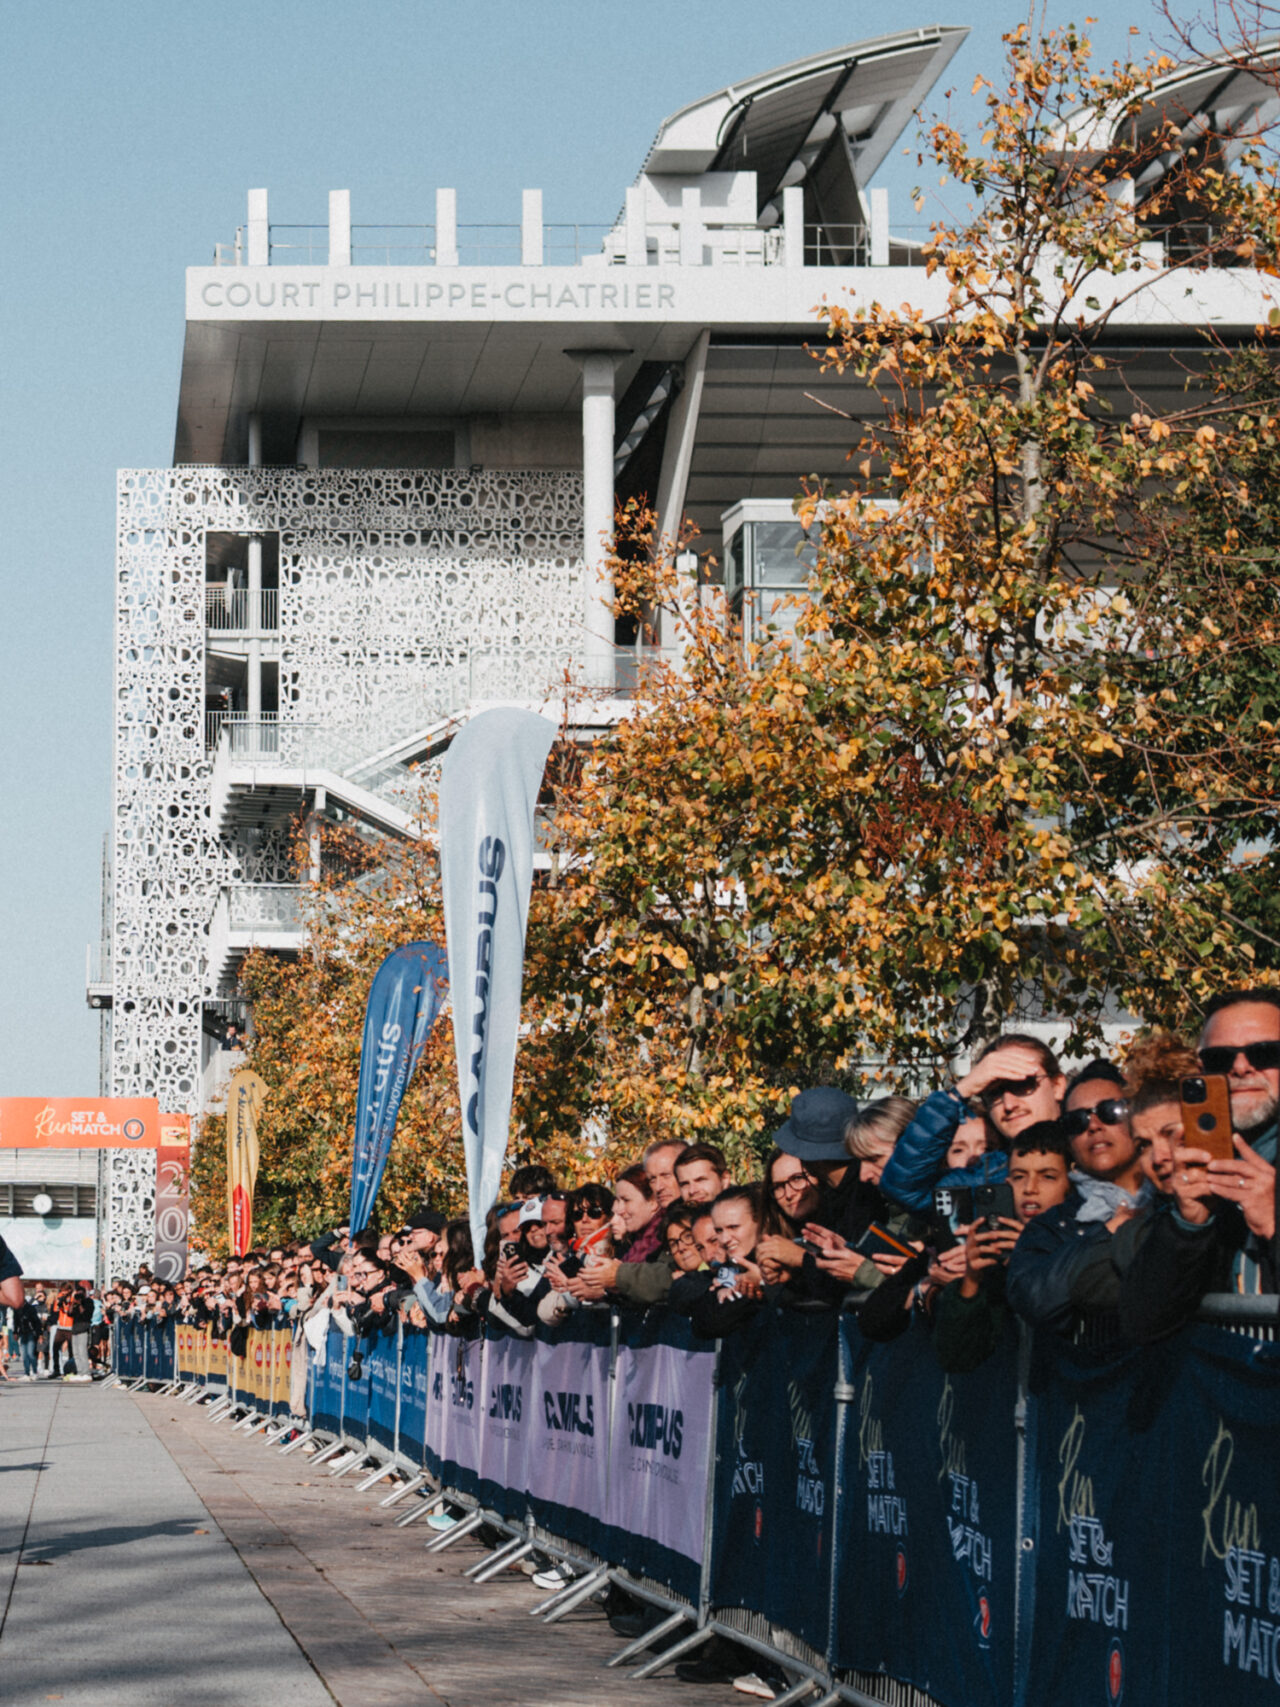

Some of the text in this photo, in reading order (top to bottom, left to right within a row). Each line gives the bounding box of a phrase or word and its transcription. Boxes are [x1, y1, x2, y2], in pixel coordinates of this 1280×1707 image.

[201, 281, 676, 309] COURT PHILIPPE-CHATRIER
[35, 1105, 72, 1138] Run
[71, 1111, 107, 1123] SET &
[71, 1123, 121, 1136] MATCH
[1056, 1402, 1096, 1534] Run
[1202, 1417, 1260, 1567] Run
[867, 1494, 908, 1537] MATCH
[1224, 1545, 1266, 1609] SET
[1066, 1570, 1129, 1631] MATCH
